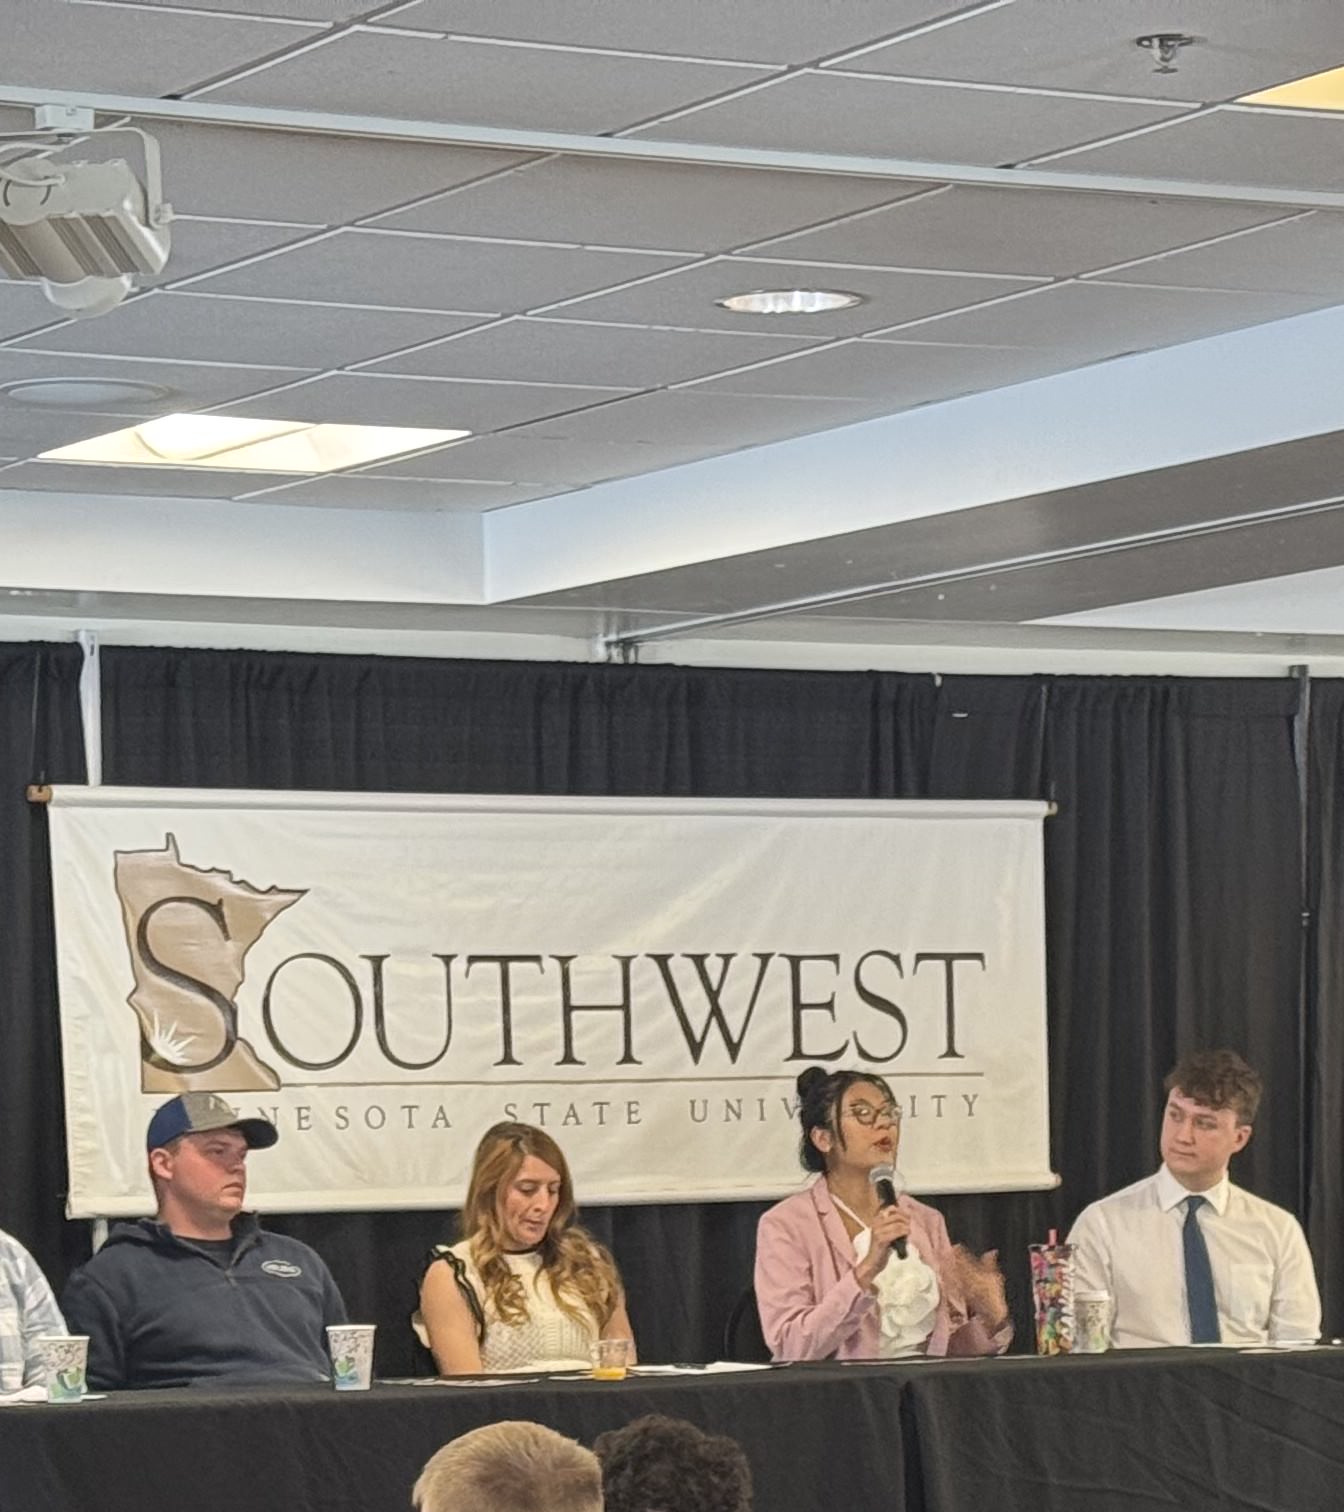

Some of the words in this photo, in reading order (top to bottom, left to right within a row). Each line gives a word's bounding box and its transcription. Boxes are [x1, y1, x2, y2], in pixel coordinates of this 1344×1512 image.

[136, 896, 986, 1074] SOUTHWEST
[504, 1100, 643, 1127] STATE
[689, 1093, 979, 1124] UNIVITY
